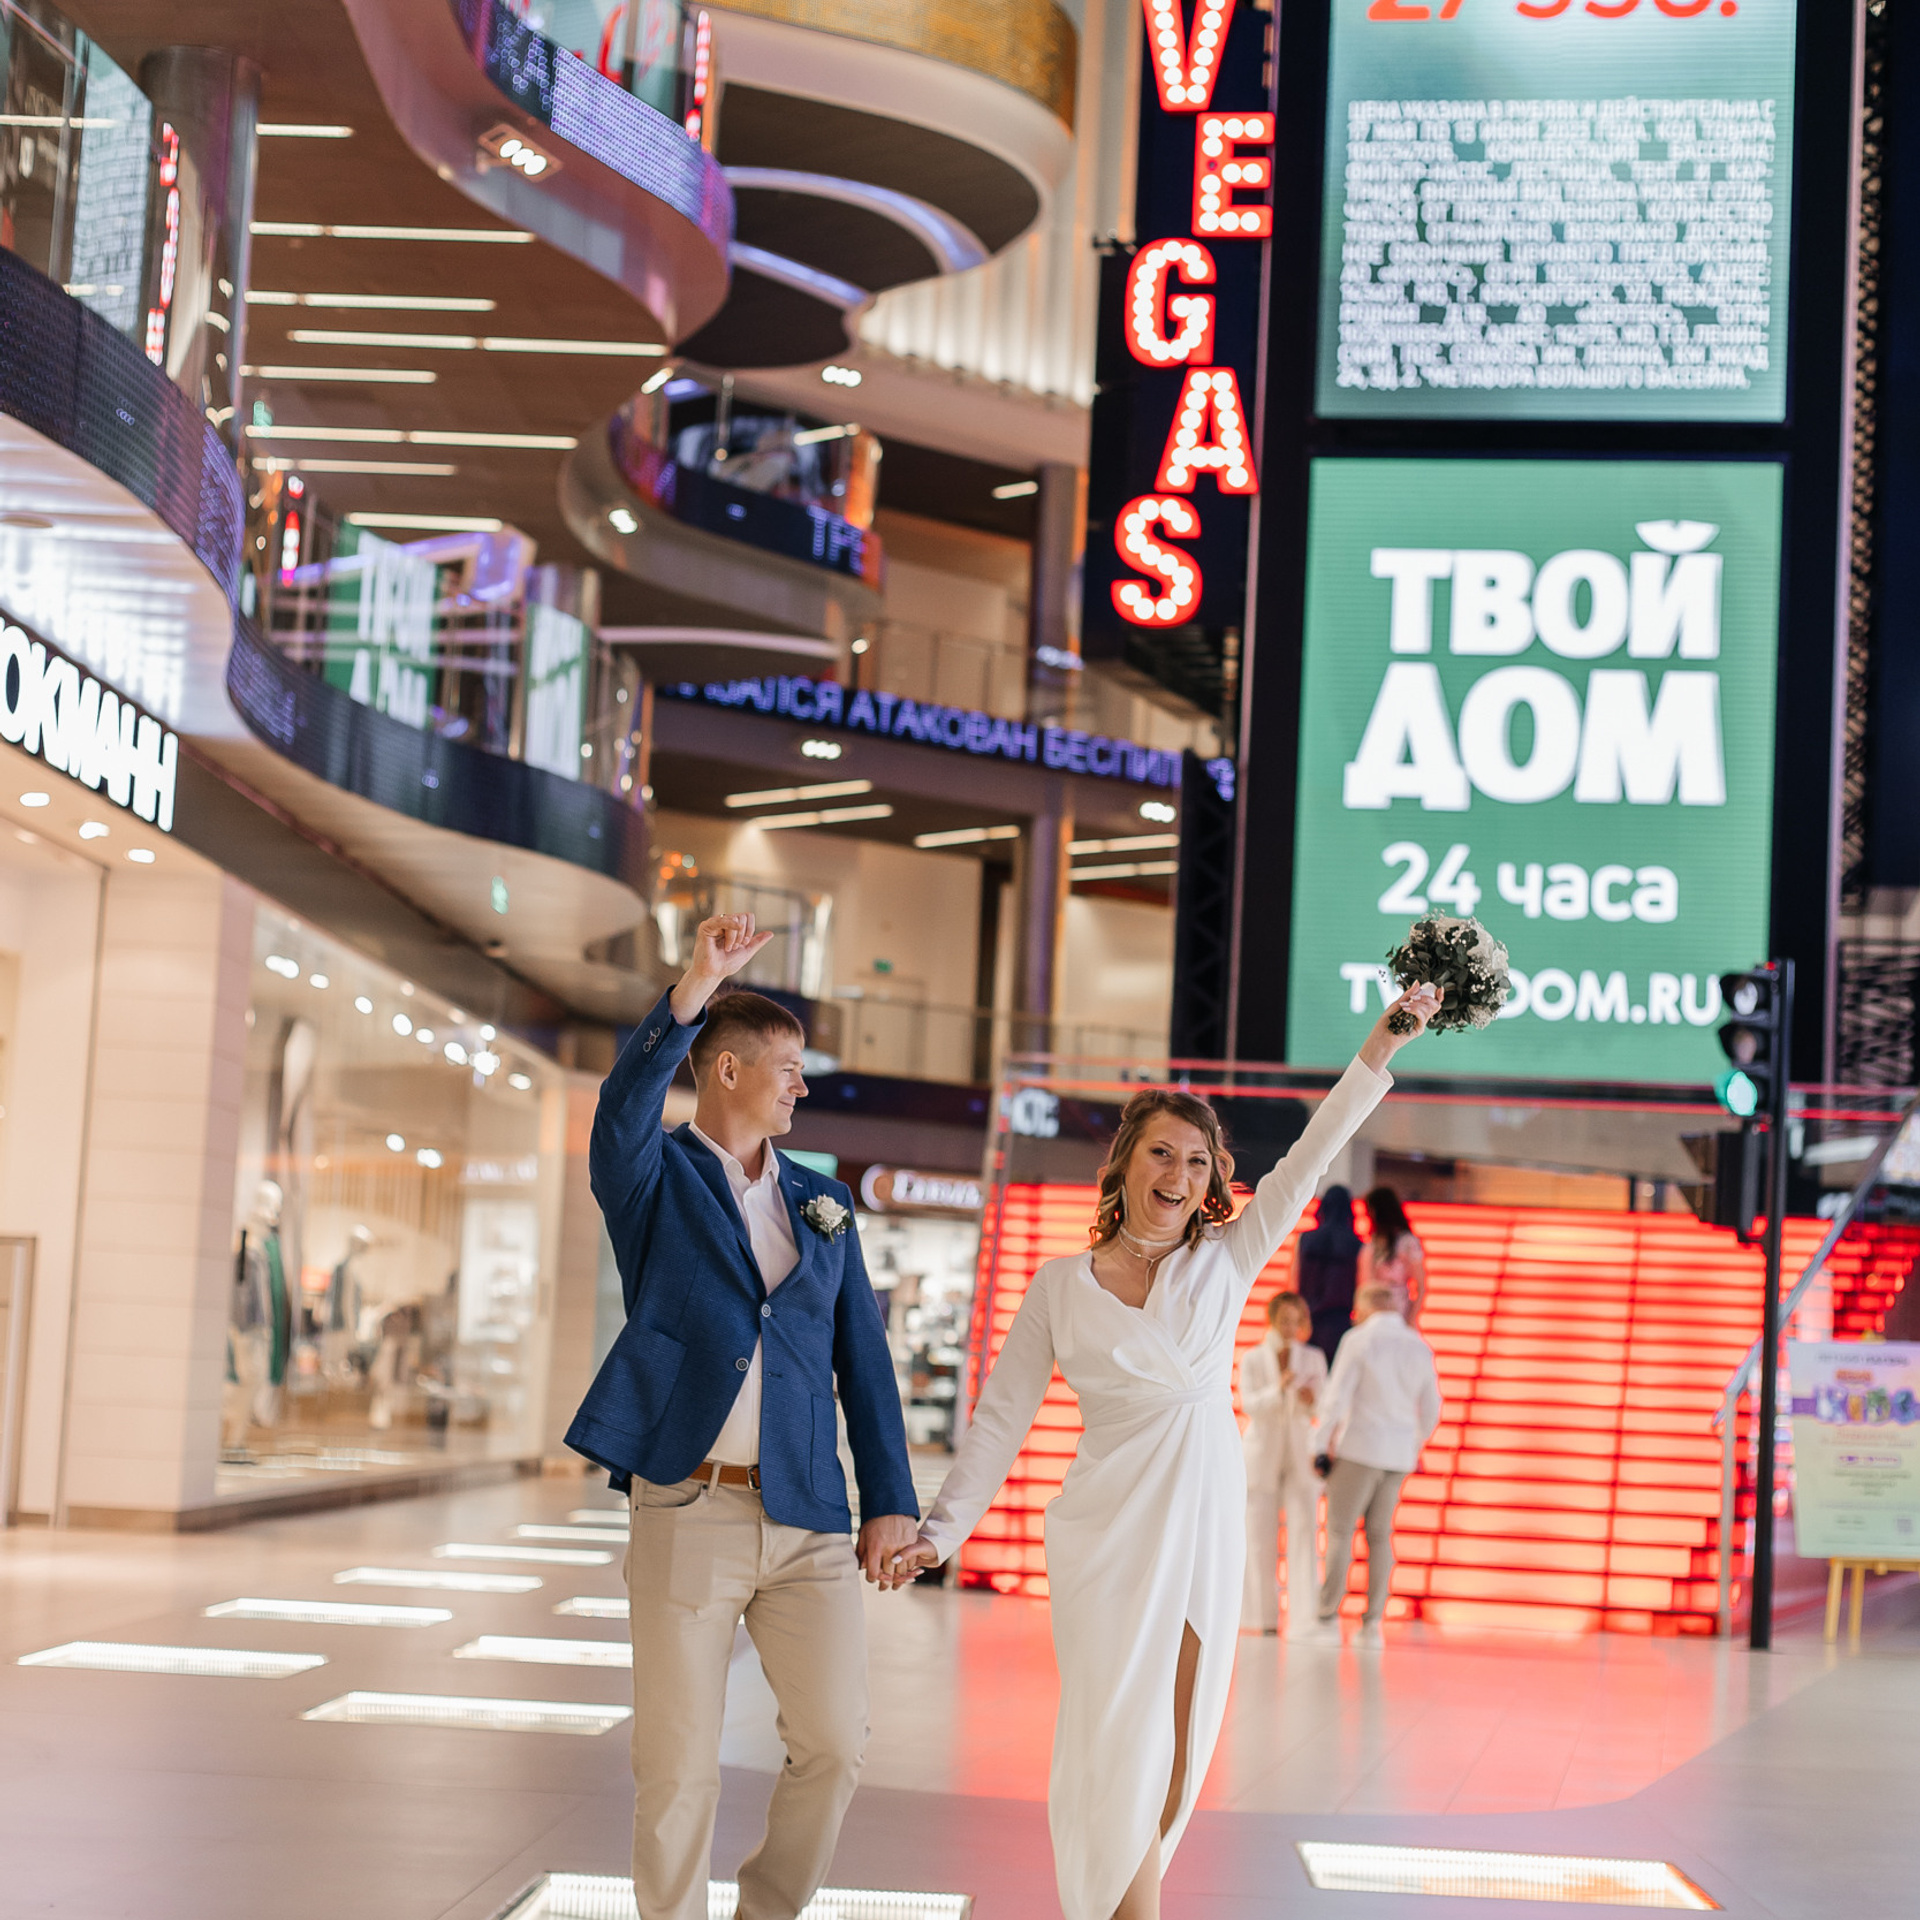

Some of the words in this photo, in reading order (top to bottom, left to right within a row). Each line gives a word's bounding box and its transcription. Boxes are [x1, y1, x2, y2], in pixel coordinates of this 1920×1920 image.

[1112, 0, 1275, 627] VEGAS
[1371, 521, 1723, 659] ТВОЙ
[0, 616, 179, 832] ОКМАНН
[847, 689, 1037, 762] АТАКОВАН
[1043, 726, 1183, 788] БЕСПИЛ
[1343, 662, 1726, 811] ДОМ
[1379, 842, 1481, 915] 24
[1498, 861, 1679, 923] часа
[1340, 962, 1722, 1026] TVDOM.RU
